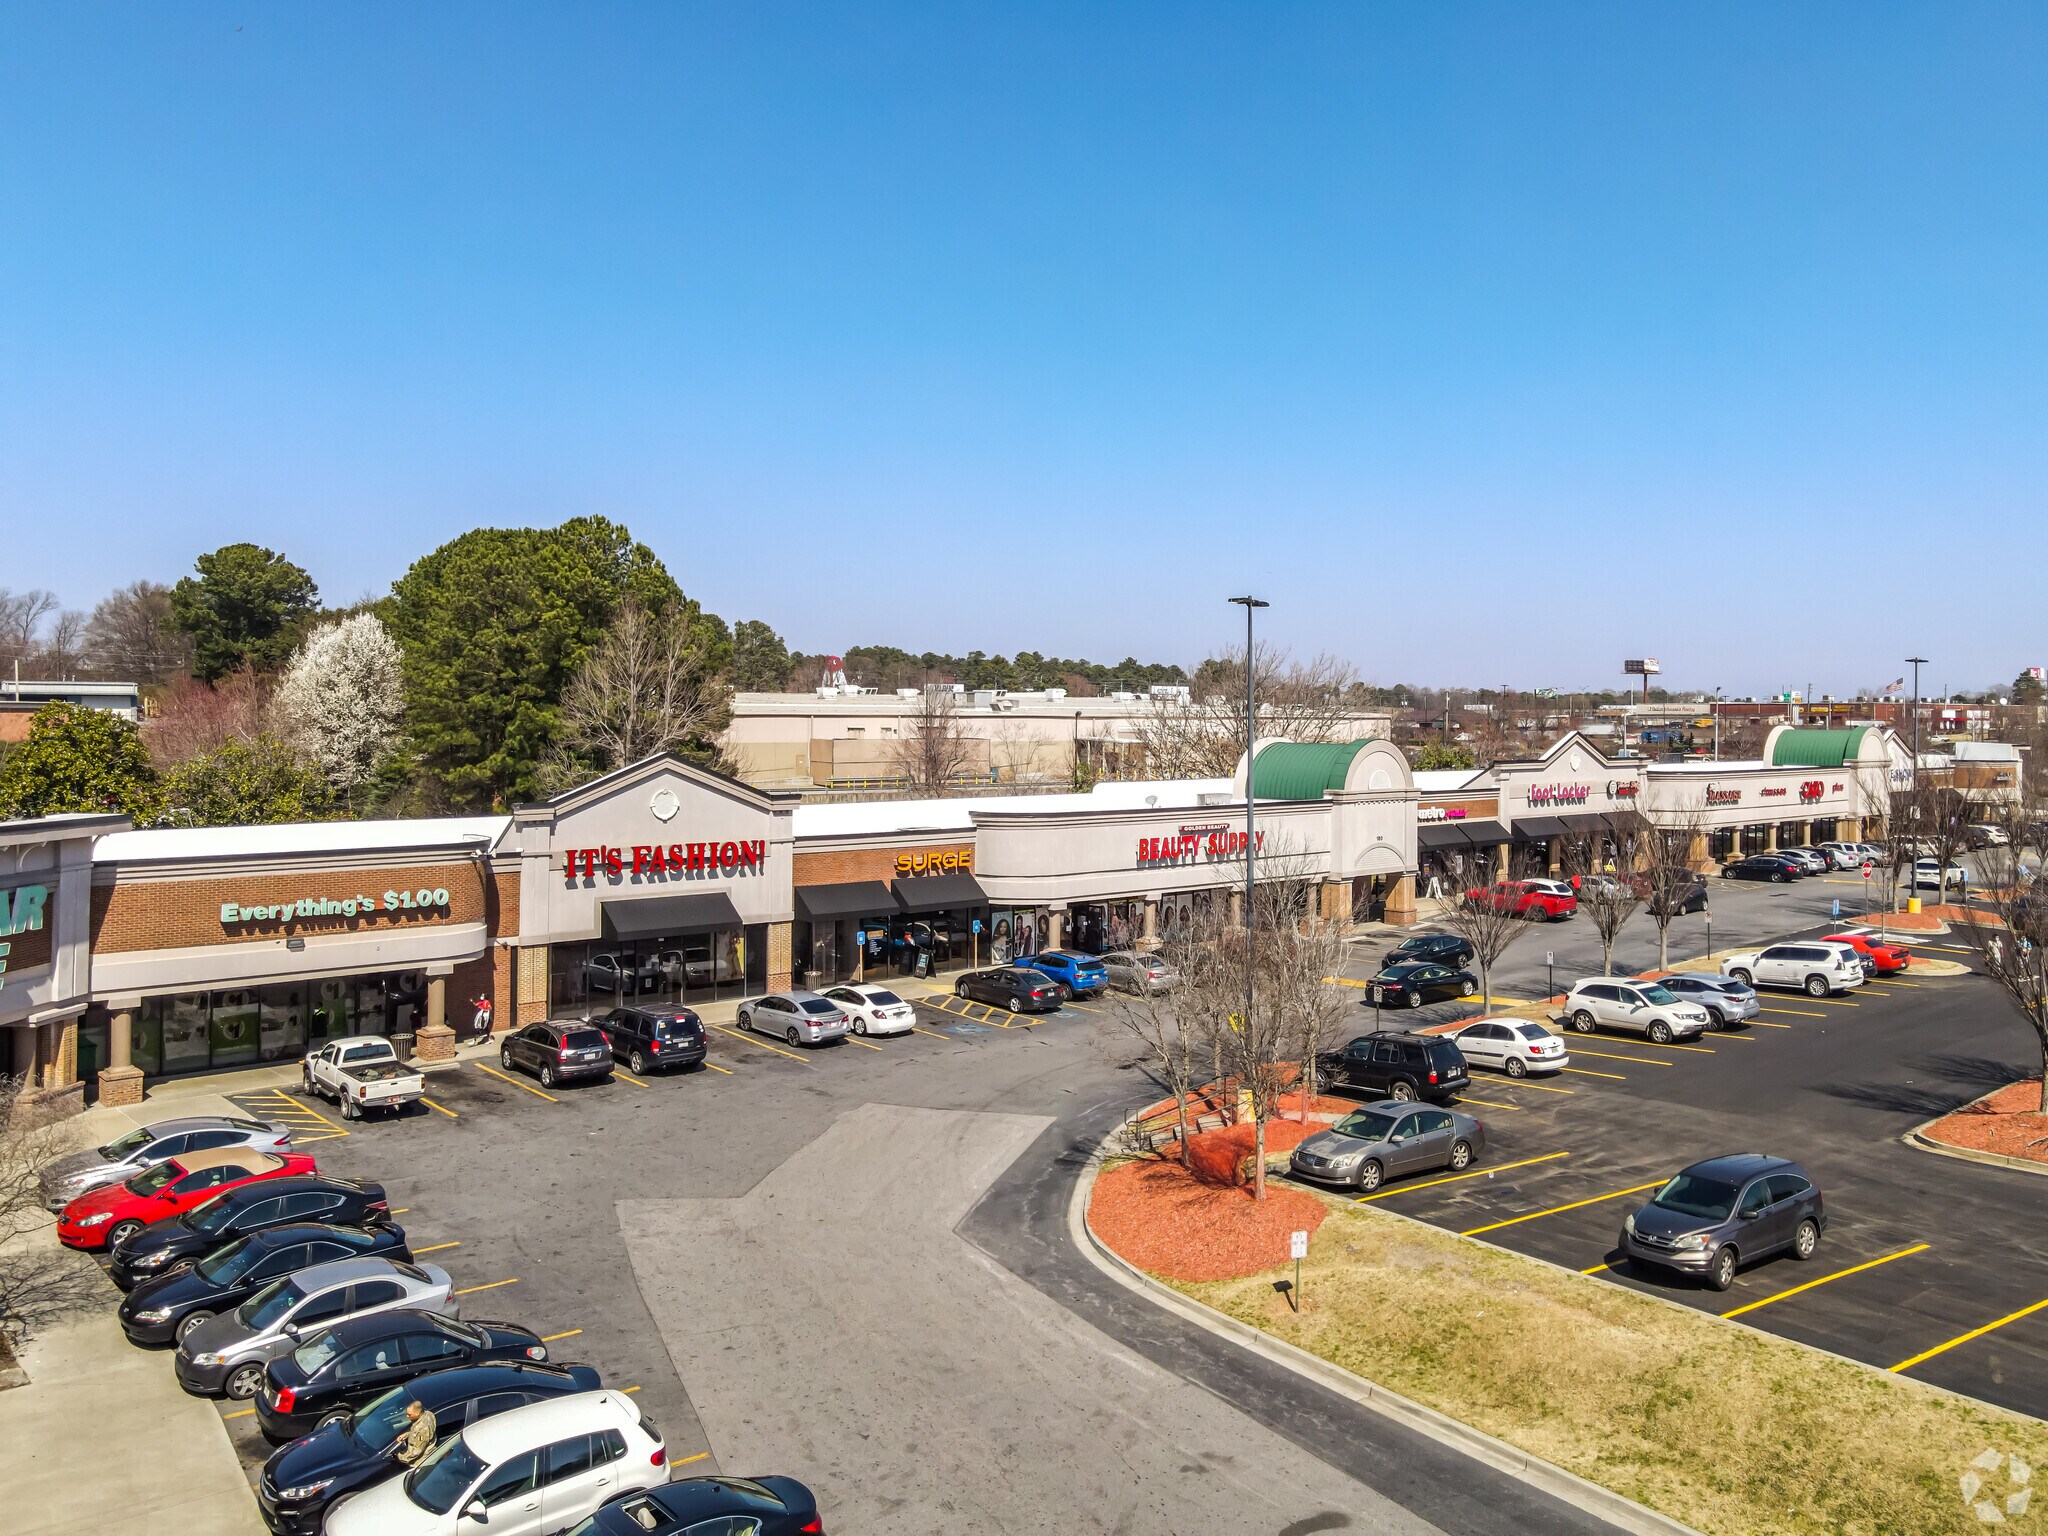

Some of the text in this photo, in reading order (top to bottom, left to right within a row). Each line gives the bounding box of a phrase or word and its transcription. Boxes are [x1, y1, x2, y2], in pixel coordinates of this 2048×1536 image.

[1531, 782, 1591, 800] Foot Locker
[1418, 806, 1446, 819] metro
[564, 839, 766, 878] IT'S FASHION!
[1139, 831, 1266, 861] BEAUTY SUPPY
[896, 849, 973, 872] SURGE
[220, 887, 450, 923] Everything's $1.00
